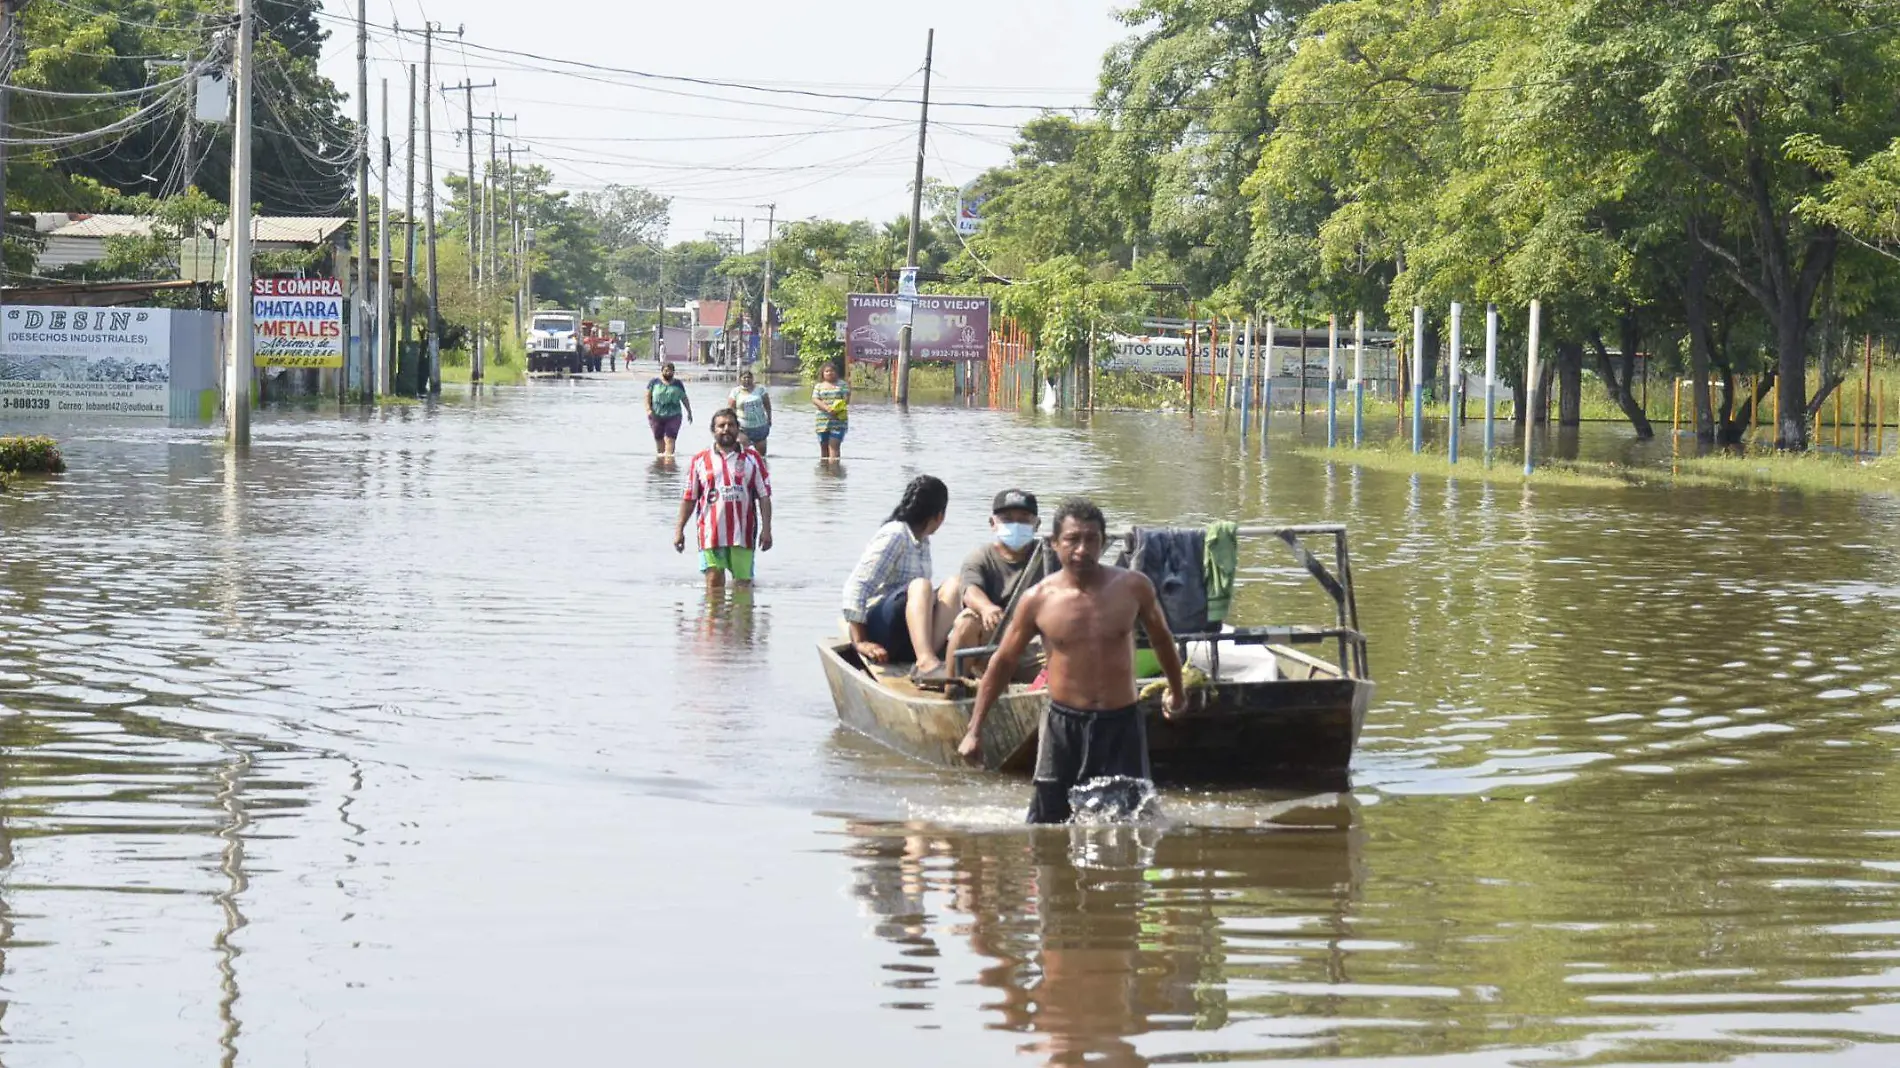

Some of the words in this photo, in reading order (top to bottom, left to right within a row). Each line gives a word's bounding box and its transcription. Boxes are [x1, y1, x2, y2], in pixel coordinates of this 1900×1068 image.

[255, 278, 273, 294] SE
[278, 279, 342, 295] COMPRA
[255, 300, 339, 317] CHATARRA
[851, 298, 898, 309] TIANGU
[254, 323, 263, 334] Y
[263, 320, 340, 337] METALES
[8, 332, 68, 343] (DESECHOS
[70, 333, 148, 344] INDUSTRIALES)
